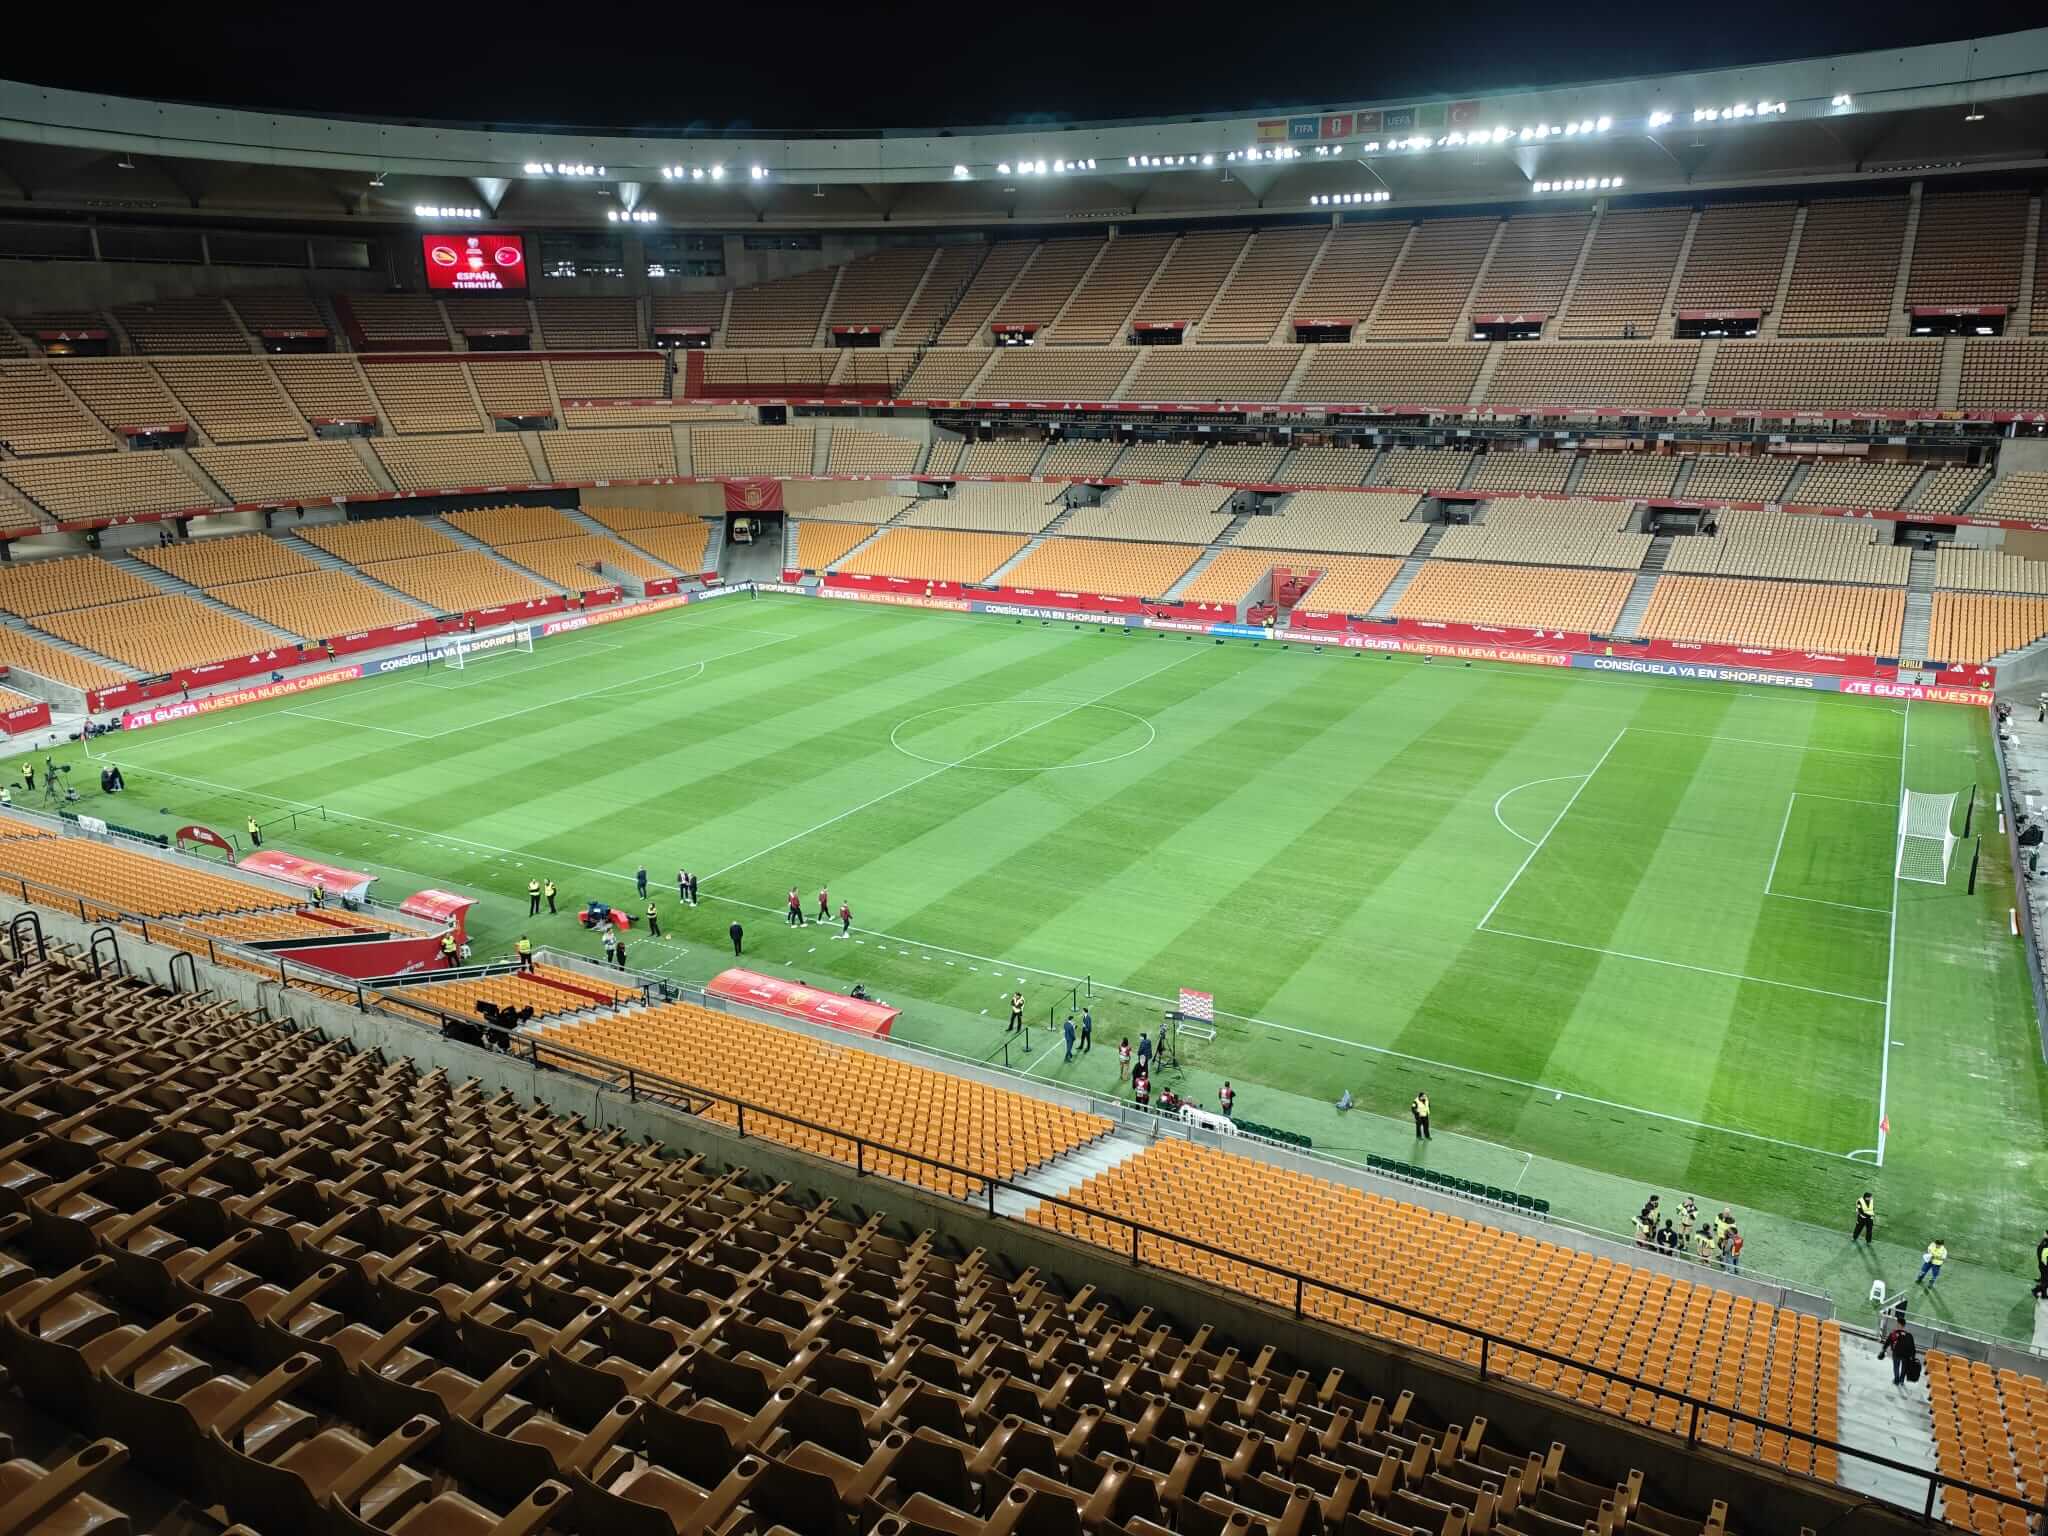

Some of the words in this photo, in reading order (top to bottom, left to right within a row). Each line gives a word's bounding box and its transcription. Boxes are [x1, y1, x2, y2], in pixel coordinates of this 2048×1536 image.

[1294, 124, 1313, 135] FIFA
[1387, 115, 1411, 127] UEFA
[456, 271, 497, 280] ESPAÑA
[1366, 639, 1400, 650] GUSTA
[1402, 642, 1457, 656] NUESTRA
[1458, 647, 1497, 659] NUEVA
[1499, 652, 1566, 666] CAMISETA?
[1594, 658, 1677, 676] CONSÍGUELA
[1679, 667, 1696, 677] YA
[1698, 668, 1717, 679] EN
[1719, 670, 1813, 688] SHOP.RFEF.ES
[154, 703, 197, 722] GUSTA
[199, 692, 257, 712] NUESTRA
[257, 682, 297, 700] NUEVA
[299, 668, 359, 689] CAMISETA?
